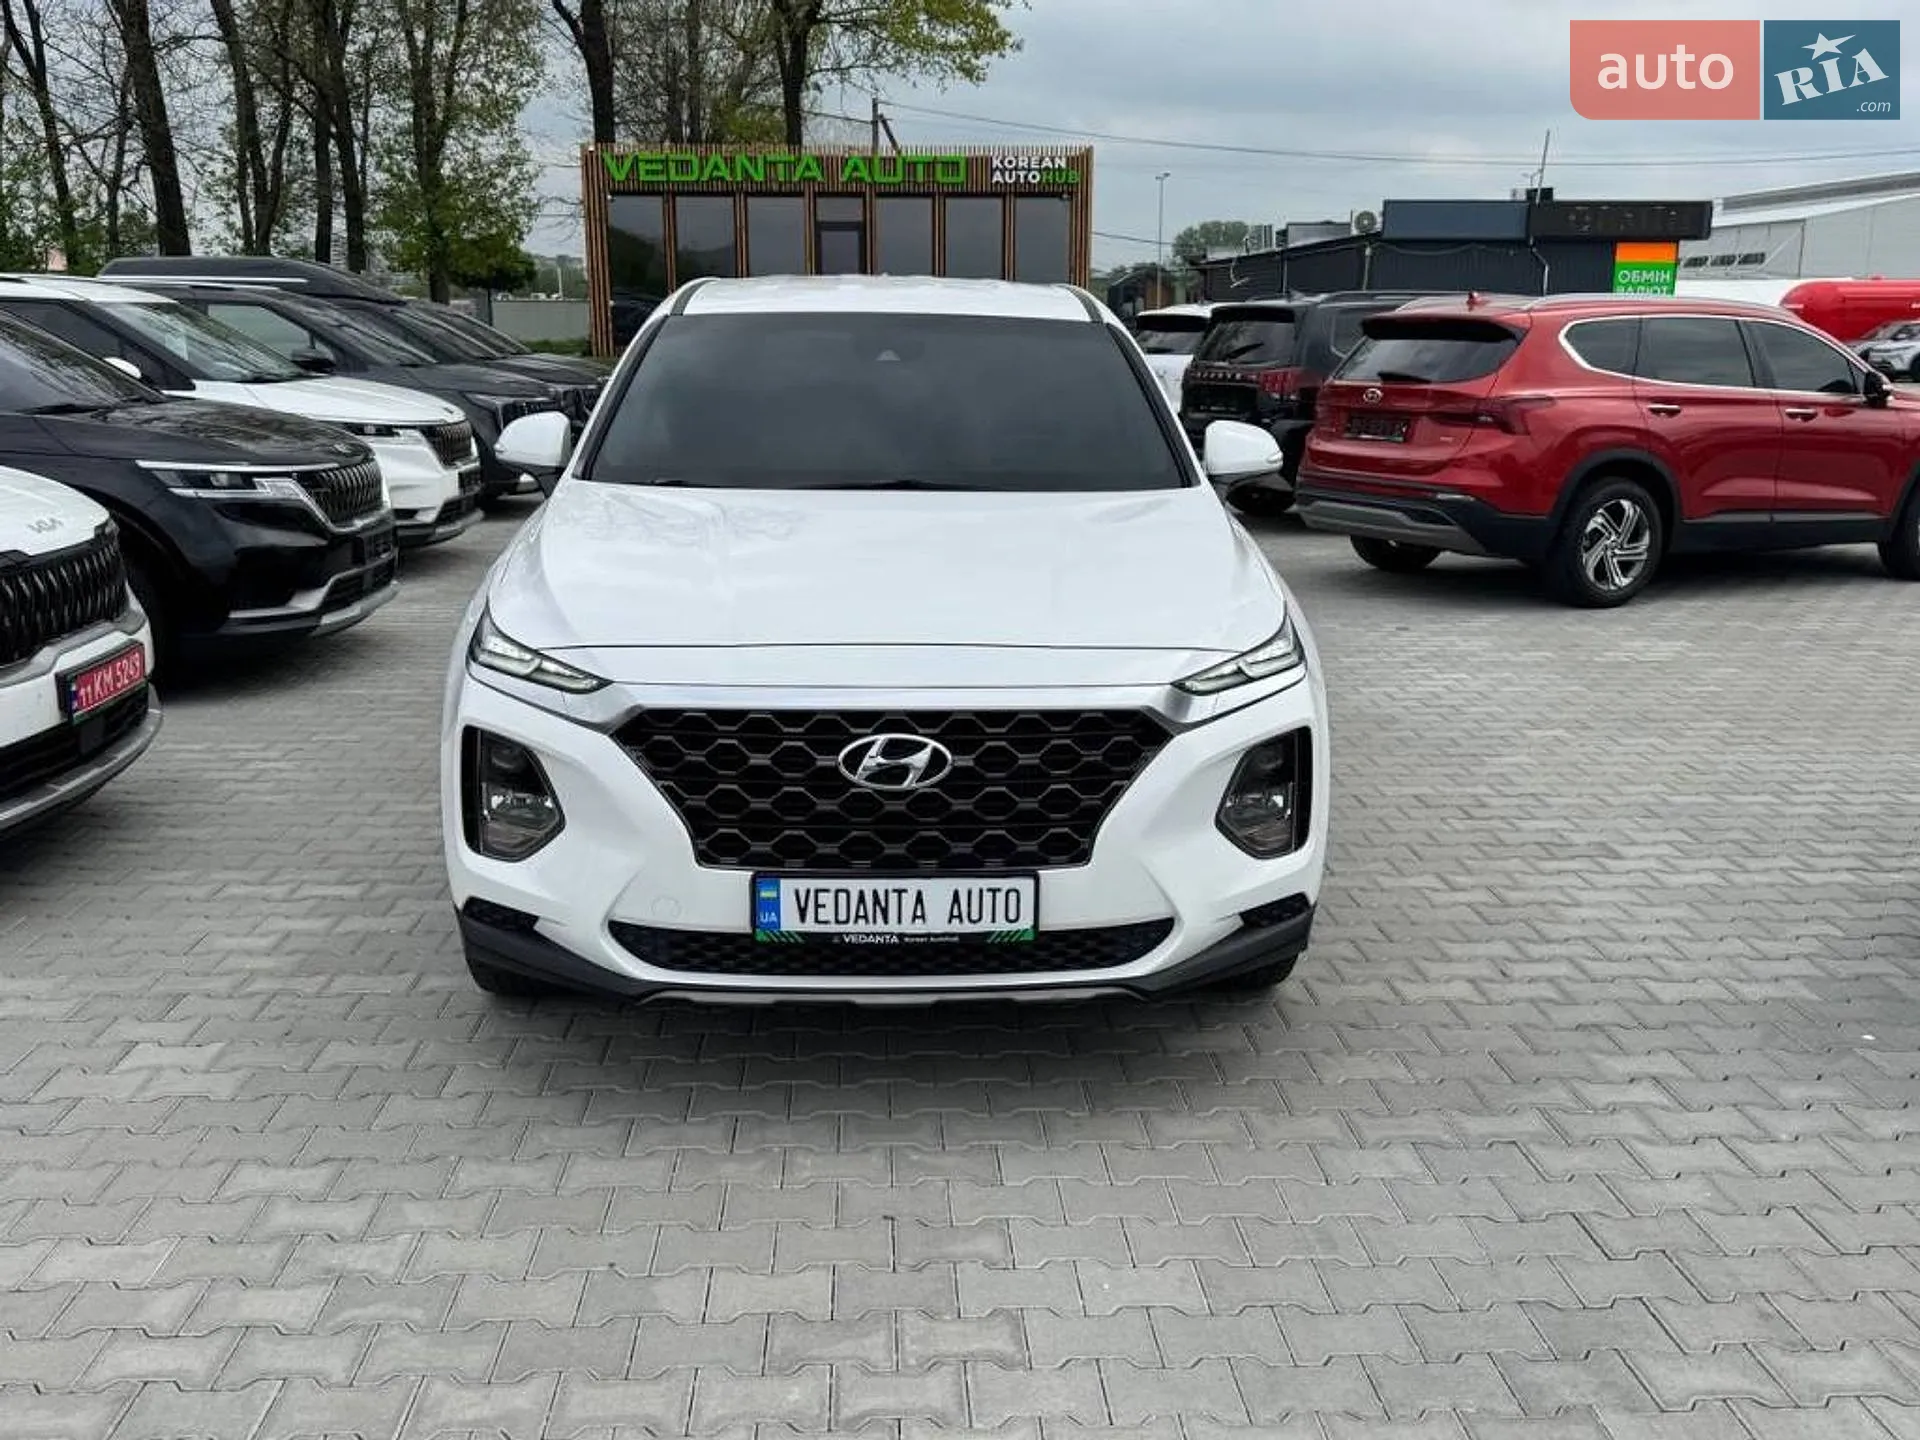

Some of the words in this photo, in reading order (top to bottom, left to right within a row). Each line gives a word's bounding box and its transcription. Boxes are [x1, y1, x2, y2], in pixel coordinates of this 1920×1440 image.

[602, 151, 825, 182] VEDANTA
[842, 153, 967, 183] AUTO
[991, 156, 1067, 168] KOREAN
[1618, 270, 1670, 284] ОБМІН
[794, 887, 927, 926] VEDANTA
[948, 886, 1022, 925] AUTO
[759, 911, 778, 923] UA
[842, 933, 900, 945] VEDANTA
